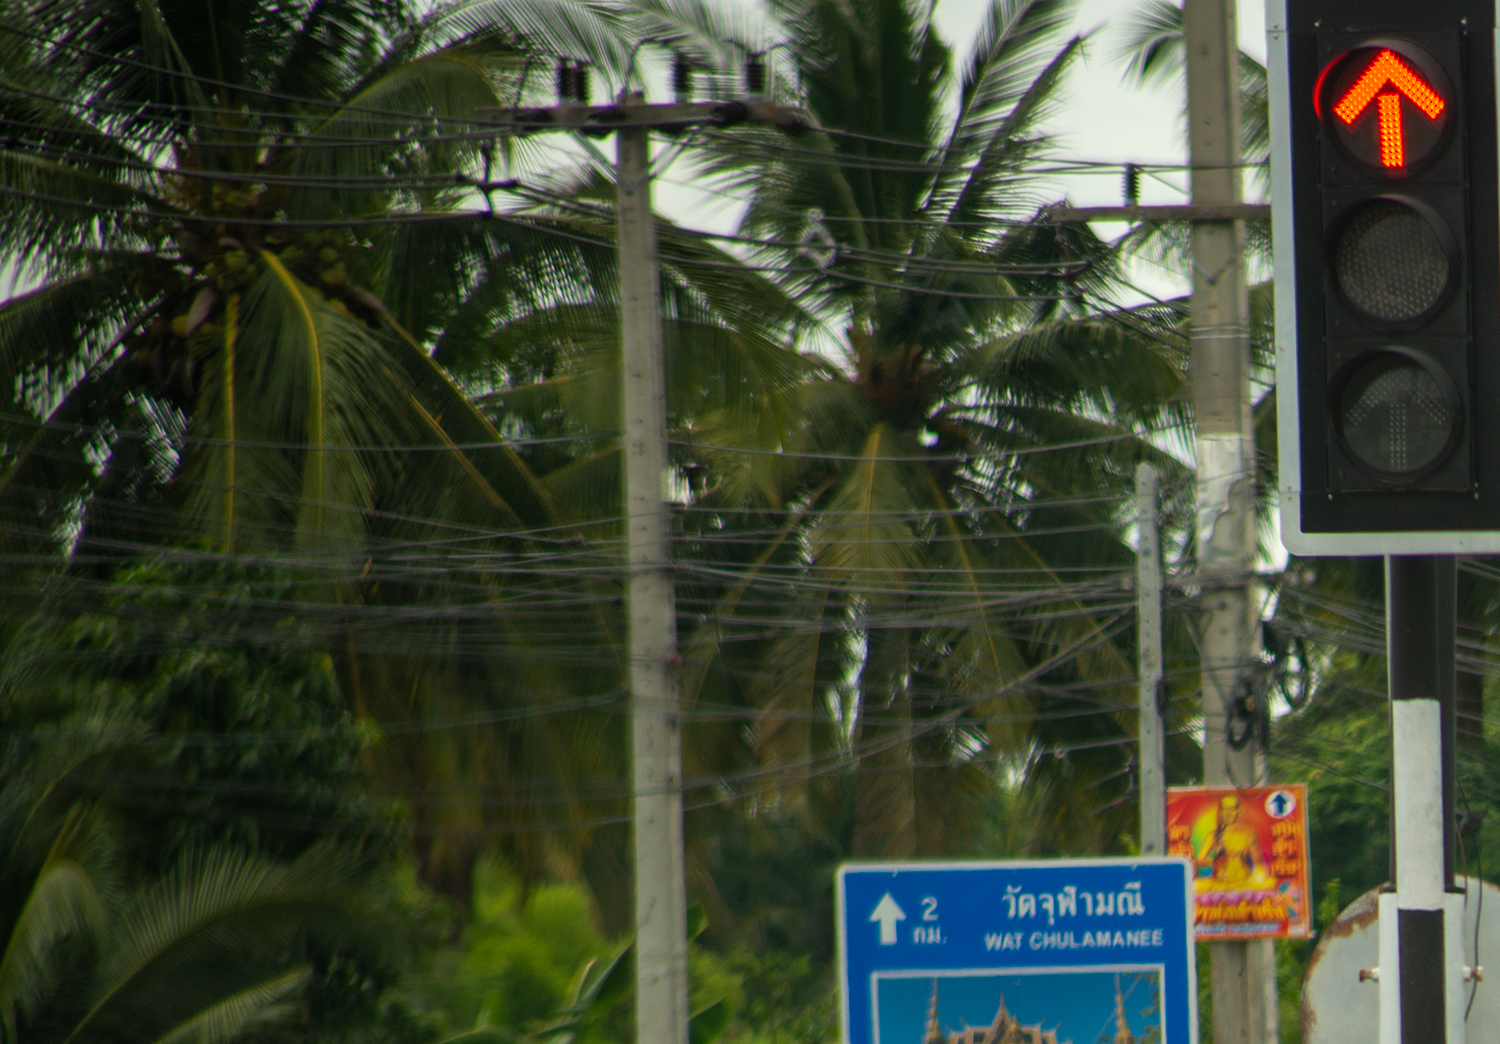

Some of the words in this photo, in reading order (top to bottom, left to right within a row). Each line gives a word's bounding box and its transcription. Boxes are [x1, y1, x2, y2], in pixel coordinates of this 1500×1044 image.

[921, 896, 938, 921] 2
[1001, 881, 1146, 926] วัดจุฬามณี
[913, 925, 947, 945] กม.
[984, 931, 1025, 951] WAT
[1028, 929, 1164, 950] CHULAMANEE
